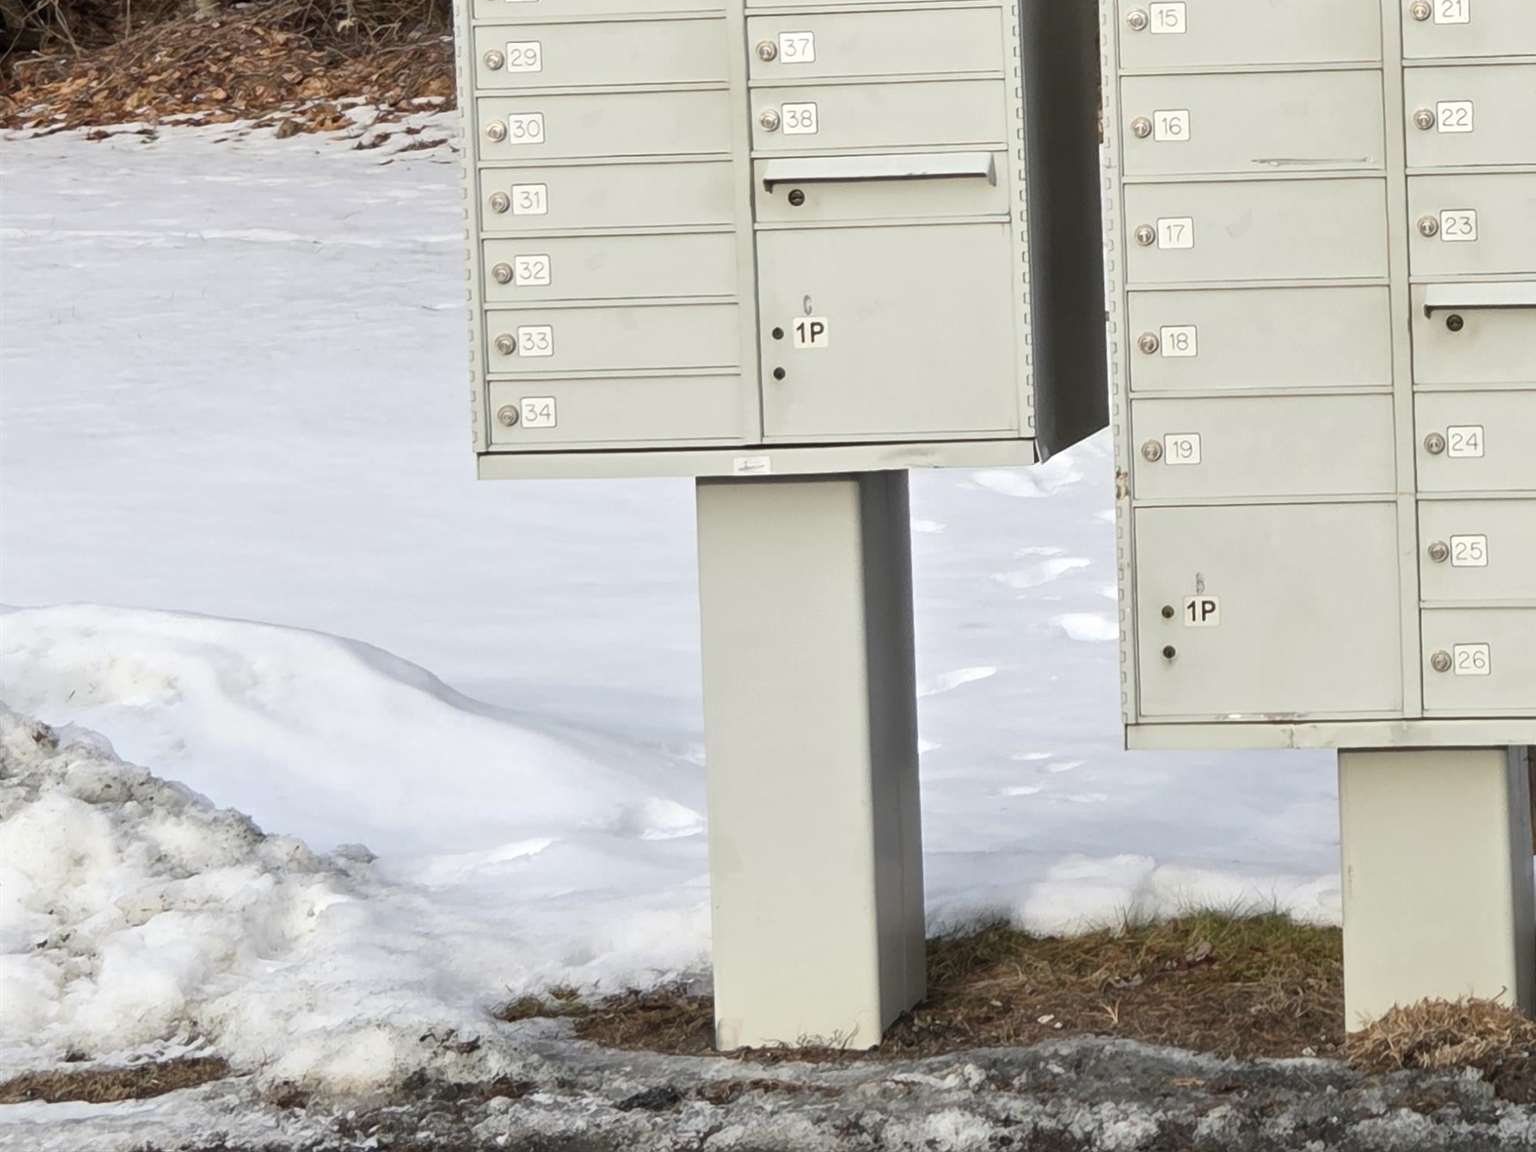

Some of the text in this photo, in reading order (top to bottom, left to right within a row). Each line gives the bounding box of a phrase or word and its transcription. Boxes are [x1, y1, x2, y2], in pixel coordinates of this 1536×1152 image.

[1158, 8, 1178, 28] 15
[1441, 0, 1462, 18] 21
[511, 48, 537, 67] 29
[784, 38, 810, 57] 37
[787, 109, 813, 129] 38
[1161, 116, 1183, 136] 16
[1441, 107, 1469, 127] 22
[513, 119, 540, 139] 30
[519, 190, 540, 210] 31
[1165, 223, 1185, 243] 17
[1445, 216, 1473, 235] 23
[520, 260, 546, 281] 32
[522, 331, 549, 351] 33
[796, 321, 825, 344] 1P
[1169, 332, 1190, 352] 18
[525, 403, 552, 422] 34
[1172, 439, 1193, 459] 19
[1451, 432, 1479, 452] 24
[1455, 541, 1483, 561] 25
[1186, 600, 1216, 622] 1P
[1458, 649, 1486, 670] 26
